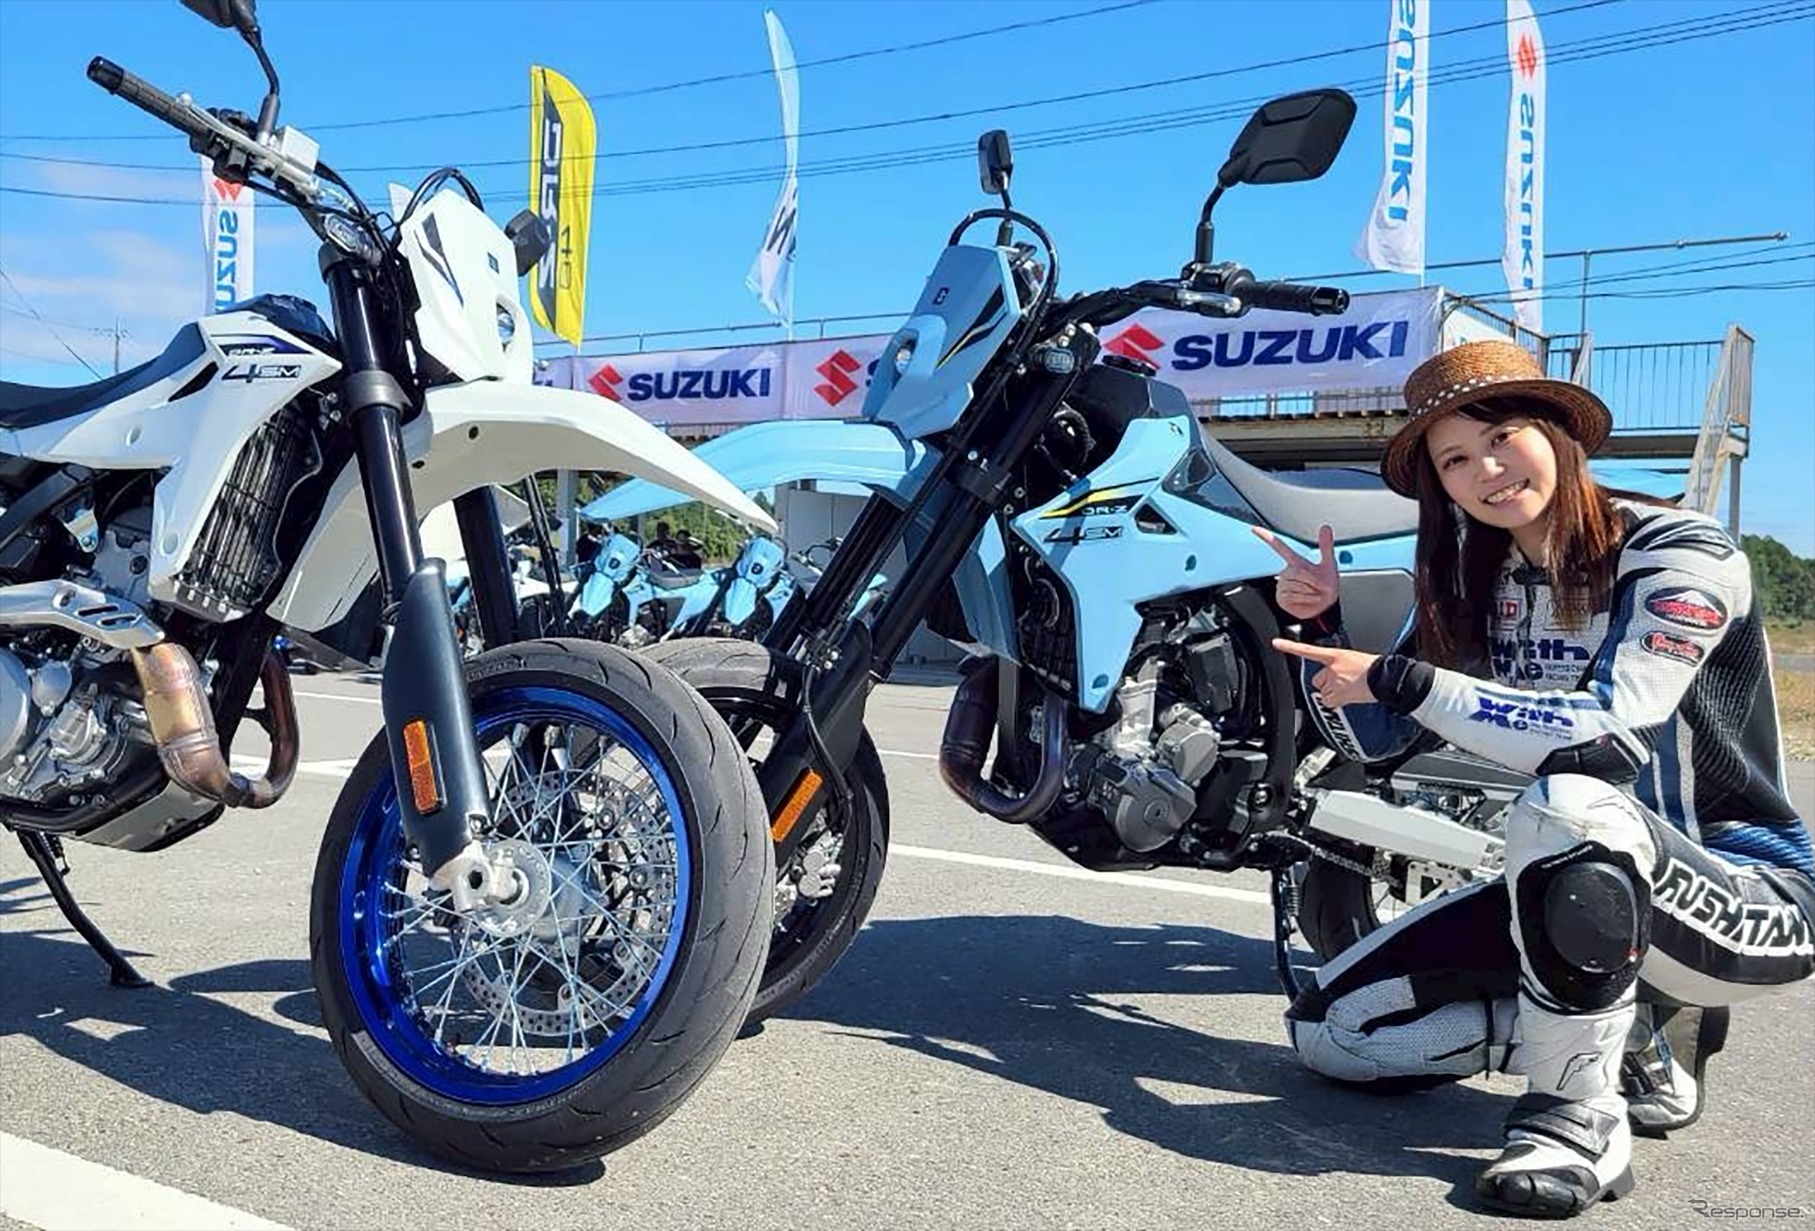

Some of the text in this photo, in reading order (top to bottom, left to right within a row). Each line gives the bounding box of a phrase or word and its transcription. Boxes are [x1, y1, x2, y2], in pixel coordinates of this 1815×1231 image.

[1171, 320, 1409, 371] SUZUKI
[627, 367, 771, 401] SUZUKI
[1081, 504, 1128, 516] DR-Z
